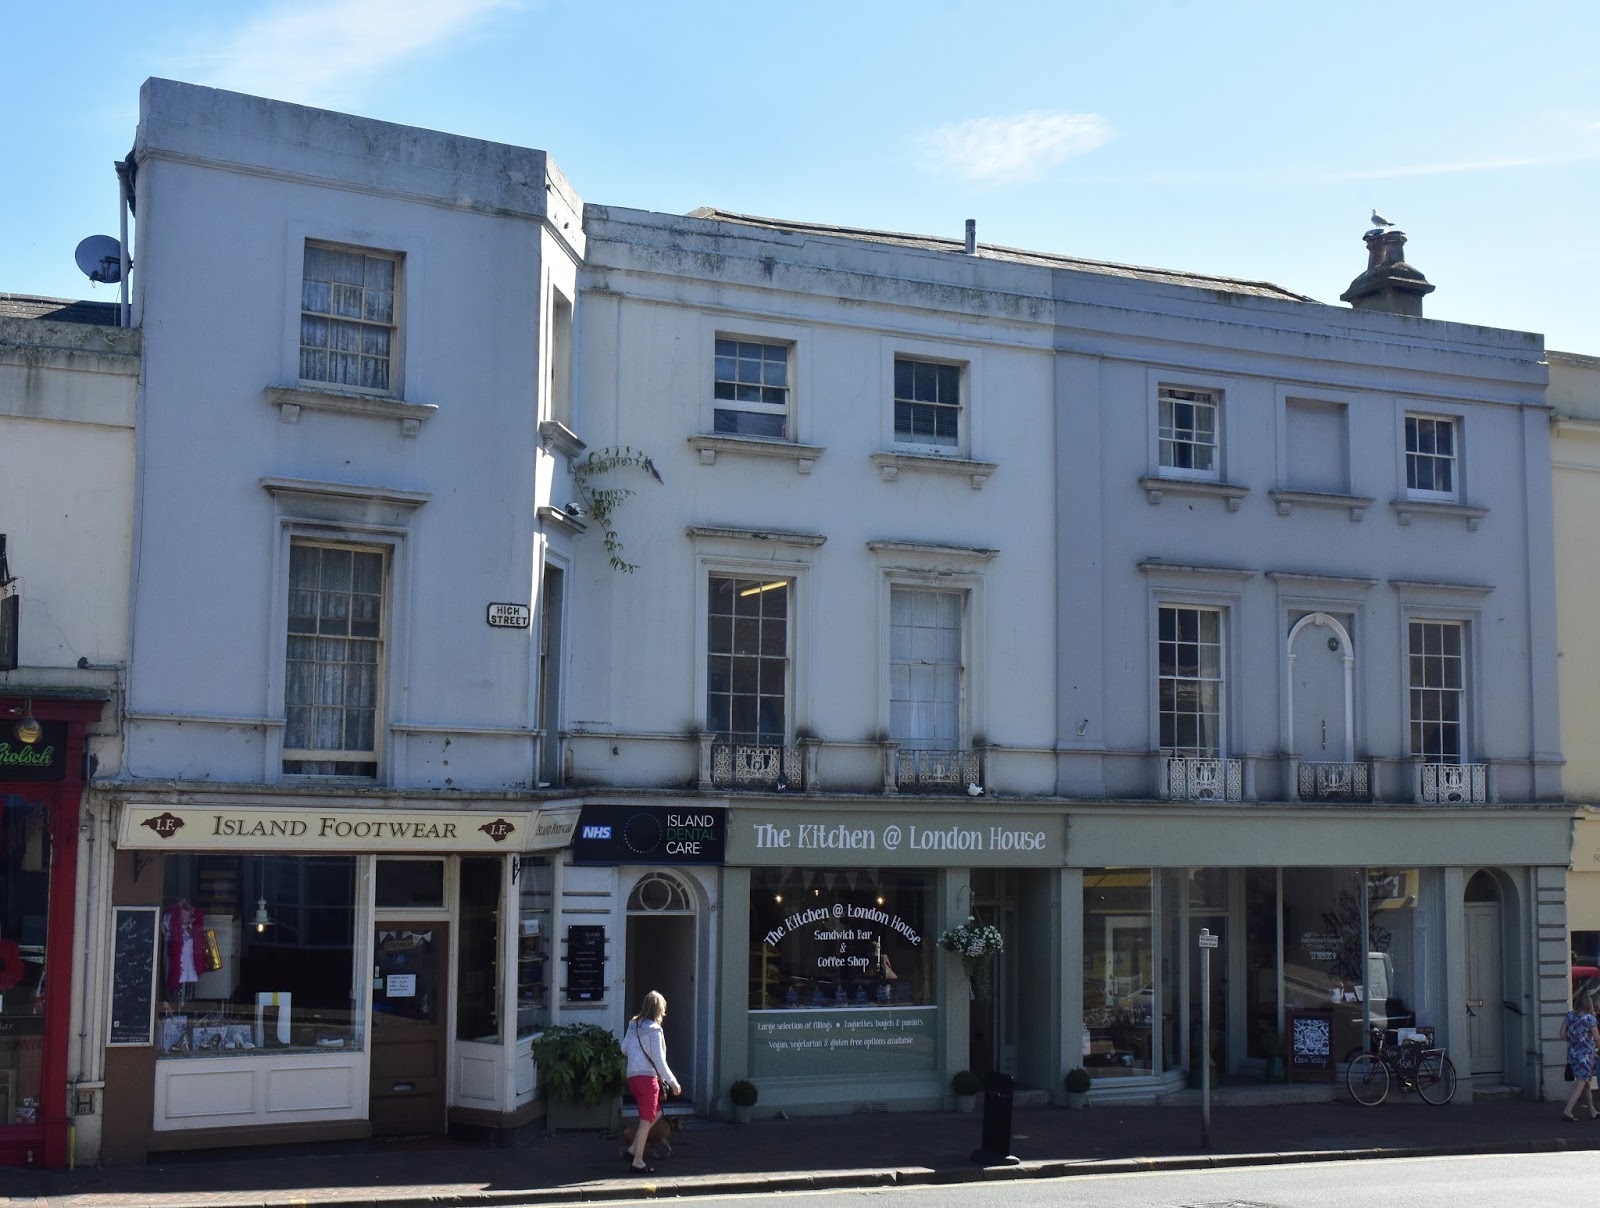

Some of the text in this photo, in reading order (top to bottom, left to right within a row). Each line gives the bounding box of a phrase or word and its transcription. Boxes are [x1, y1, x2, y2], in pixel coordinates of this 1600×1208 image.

[497, 606, 519, 615] HIGH
[491, 615, 527, 625] STREET
[212, 815, 458, 839] ISLAND FOOTWEAR
[666, 814, 714, 828] ISLAND
[583, 826, 611, 839] NHS
[666, 828, 716, 841] DENTAL
[753, 823, 1046, 851] The Kitchen @ London House
[666, 841, 701, 855] CARE
[763, 903, 922, 947] The Kitchen @ London House
[814, 929, 873, 941] Sandwich Bar
[839, 941, 847, 953] &
[817, 956, 869, 973] Coffee Shop
[757, 1022, 776, 1034] Large
[776, 1021, 804, 1030] selection
[804, 1021, 812, 1029] of
[813, 1020, 833, 1033] fillings
[875, 1019, 895, 1031] bagels
[790, 1039, 822, 1051] vegetarian
[823, 1038, 828, 1046] &
[830, 1038, 849, 1050] gluten
[849, 1038, 863, 1046] free
[864, 1037, 886, 1050] options
[887, 1036, 914, 1045] available
